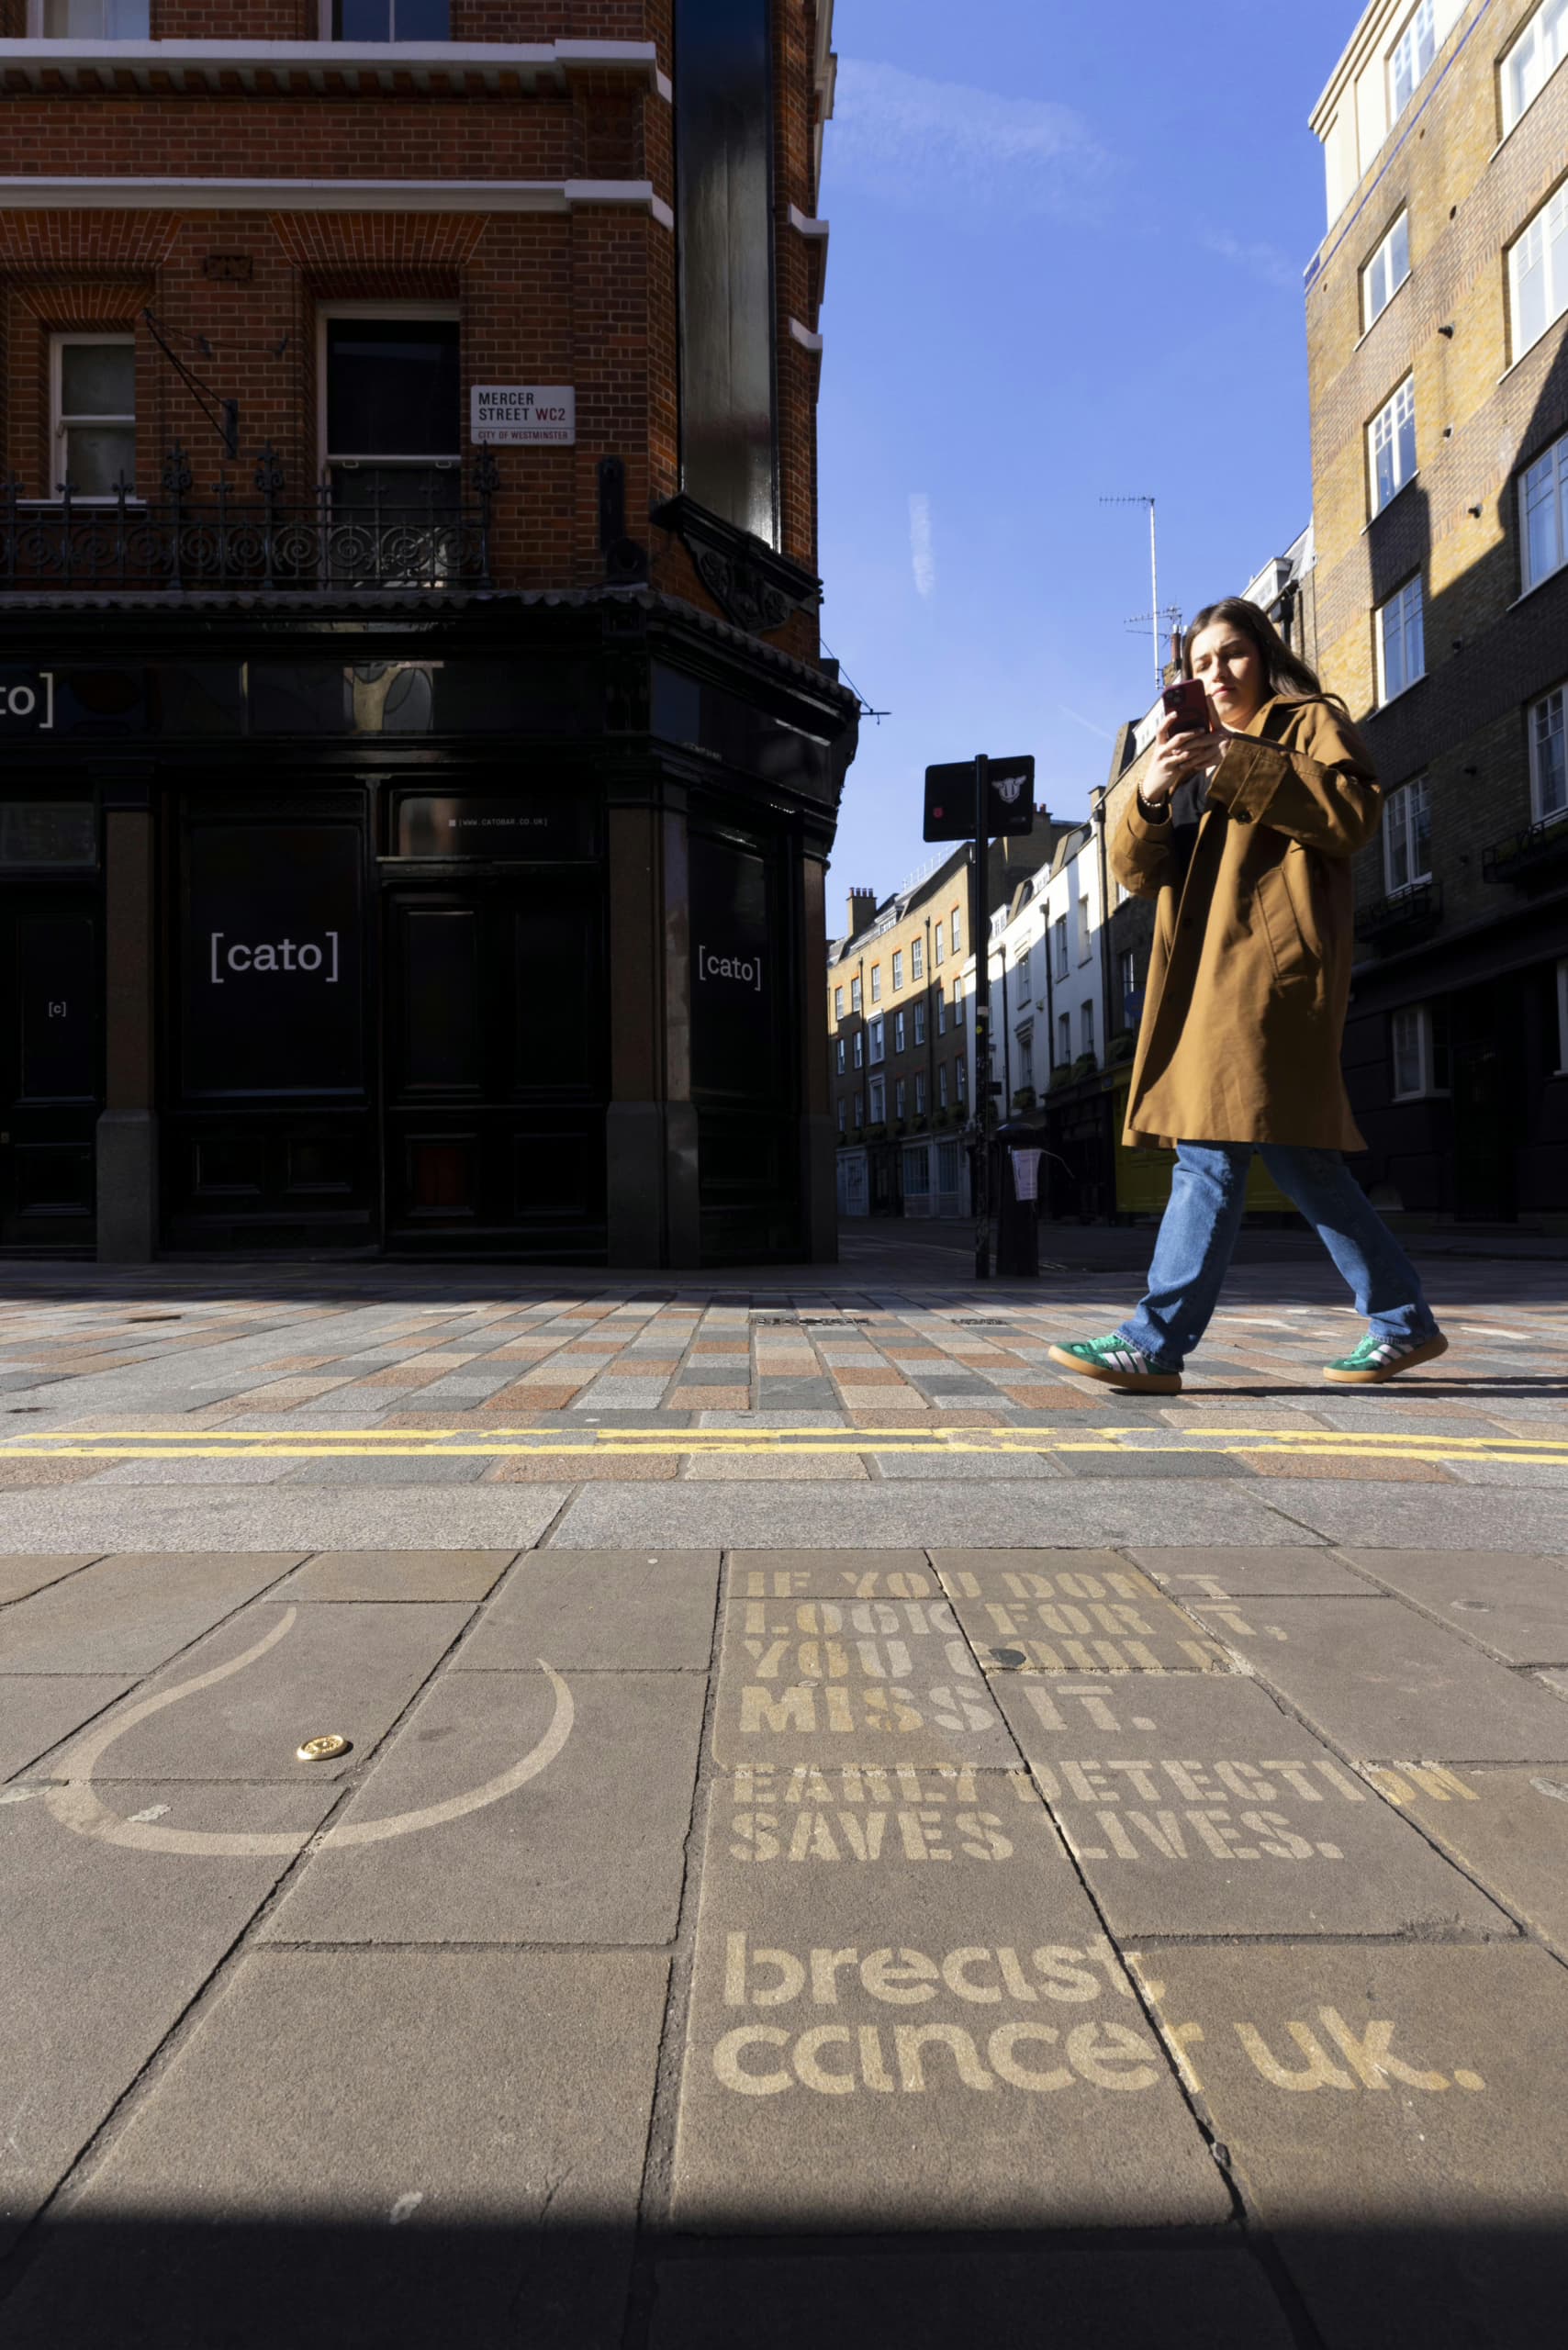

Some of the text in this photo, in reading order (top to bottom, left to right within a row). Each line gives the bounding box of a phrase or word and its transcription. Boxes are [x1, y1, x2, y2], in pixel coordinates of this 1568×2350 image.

[478, 392, 534, 405] MERCER
[478, 408, 566, 421] STREET WC2
[477, 431, 568, 440] CITY OF WESTMINSTER
[747, 1572, 811, 1598] IF
[840, 1572, 981, 1598] YOU
[745, 1603, 964, 1634] LOOK
[985, 1604, 1157, 1635] FOR
[743, 1640, 913, 1679] YOU
[739, 1685, 1157, 1733] MISS IT.
[734, 1760, 1481, 1805] EARLY DETECTION
[729, 1811, 1345, 1862] SAVES LIVES.
[724, 1930, 1166, 2007] breast
[712, 2005, 1486, 2096] cancer uk.
